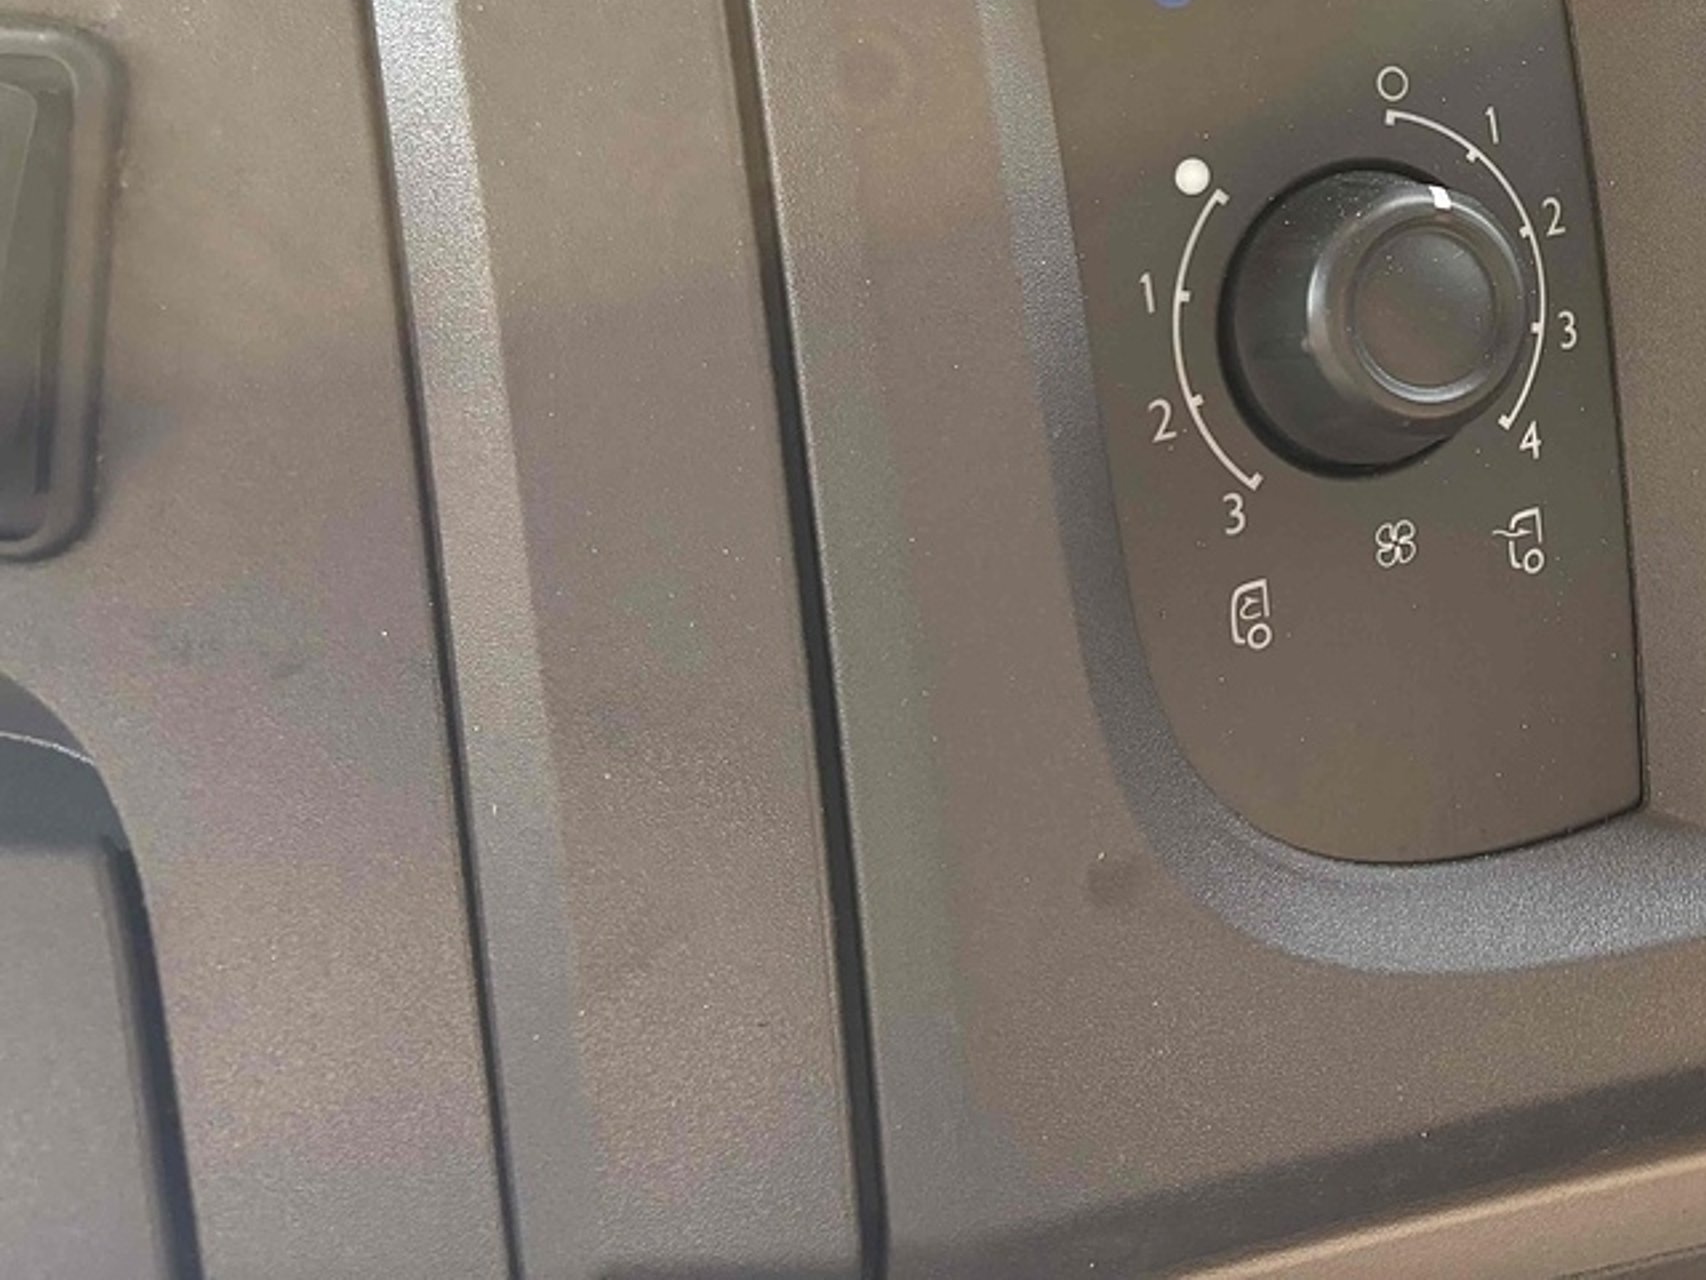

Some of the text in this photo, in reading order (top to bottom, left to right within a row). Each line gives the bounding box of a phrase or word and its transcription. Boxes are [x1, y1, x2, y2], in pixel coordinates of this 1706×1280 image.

[1485, 106, 1500, 144] 1
[1542, 197, 1567, 236] 2
[1139, 272, 1155, 313] 1
[1558, 311, 1578, 349] 3
[1148, 398, 1177, 443] 2
[1519, 421, 1542, 459] 4
[1222, 493, 1247, 535] 3
